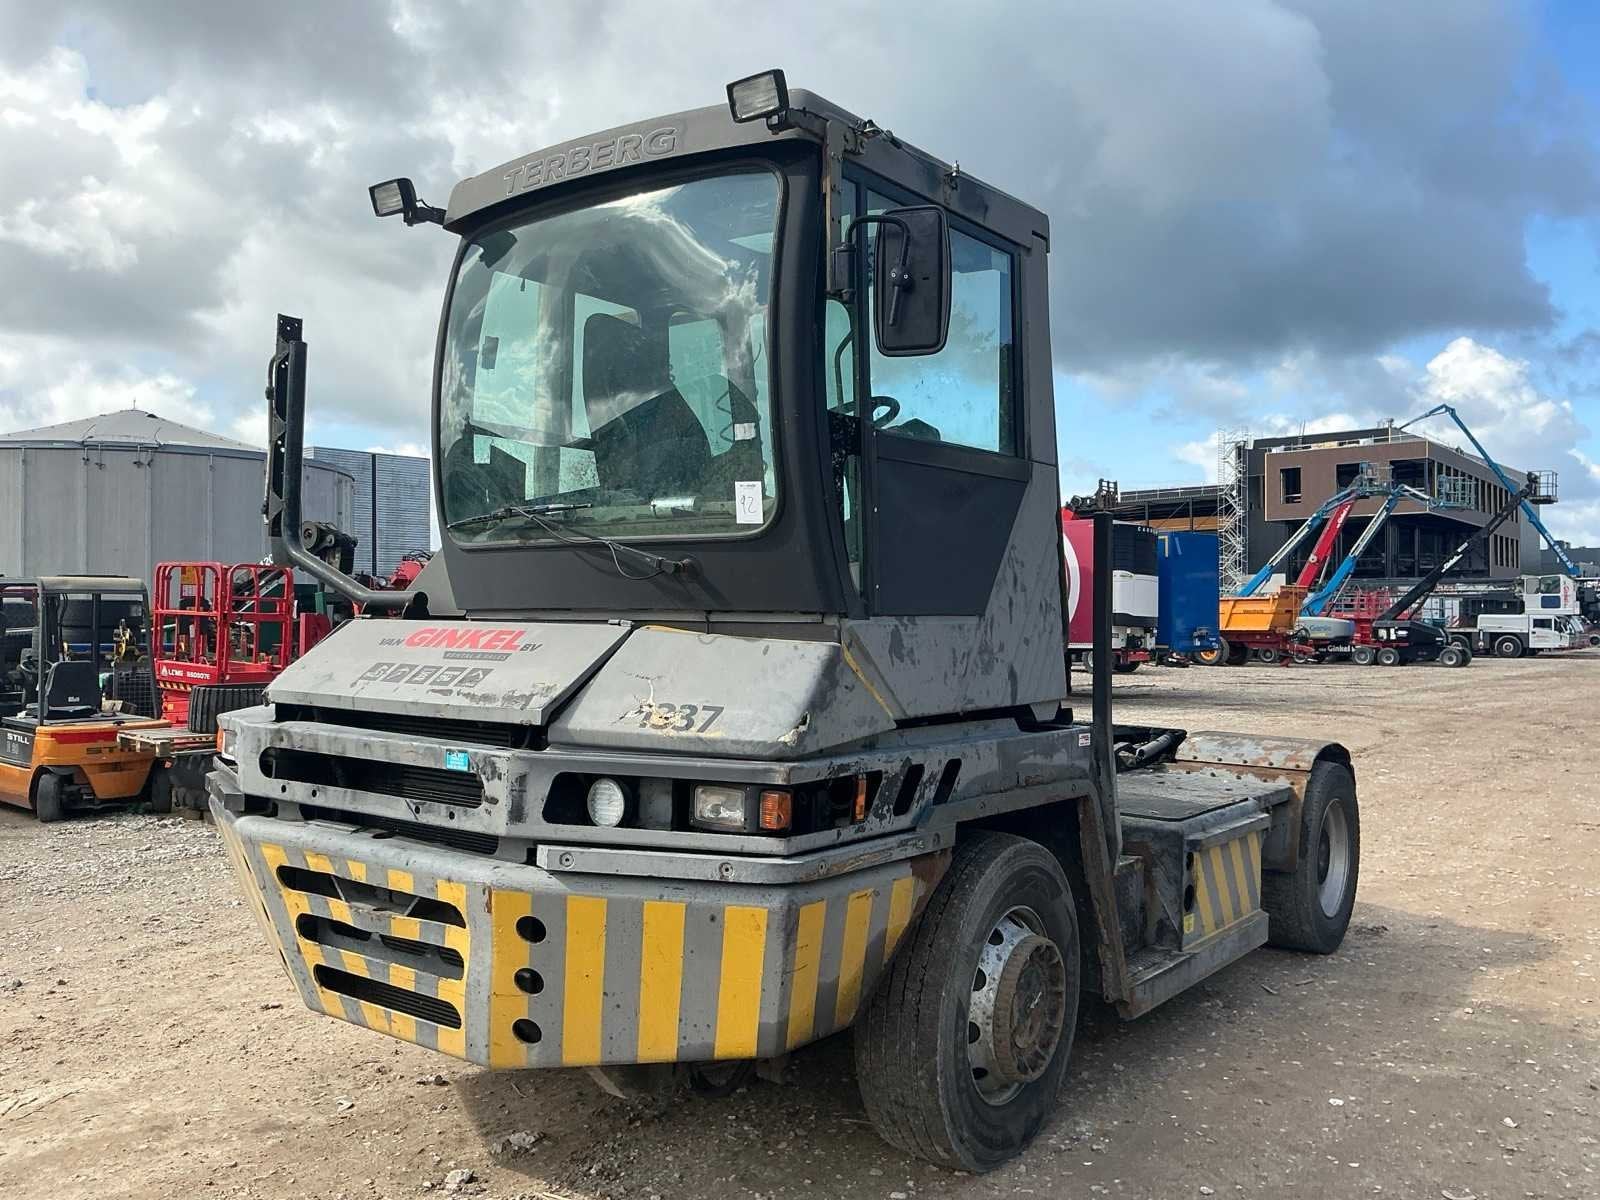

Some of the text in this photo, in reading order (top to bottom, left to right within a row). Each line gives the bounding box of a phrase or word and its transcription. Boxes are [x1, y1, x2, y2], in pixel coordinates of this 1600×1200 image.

[503, 127, 677, 196] TERBERG
[379, 628, 543, 652] VAN GINKEL BV
[7, 733, 30, 745] STILL
